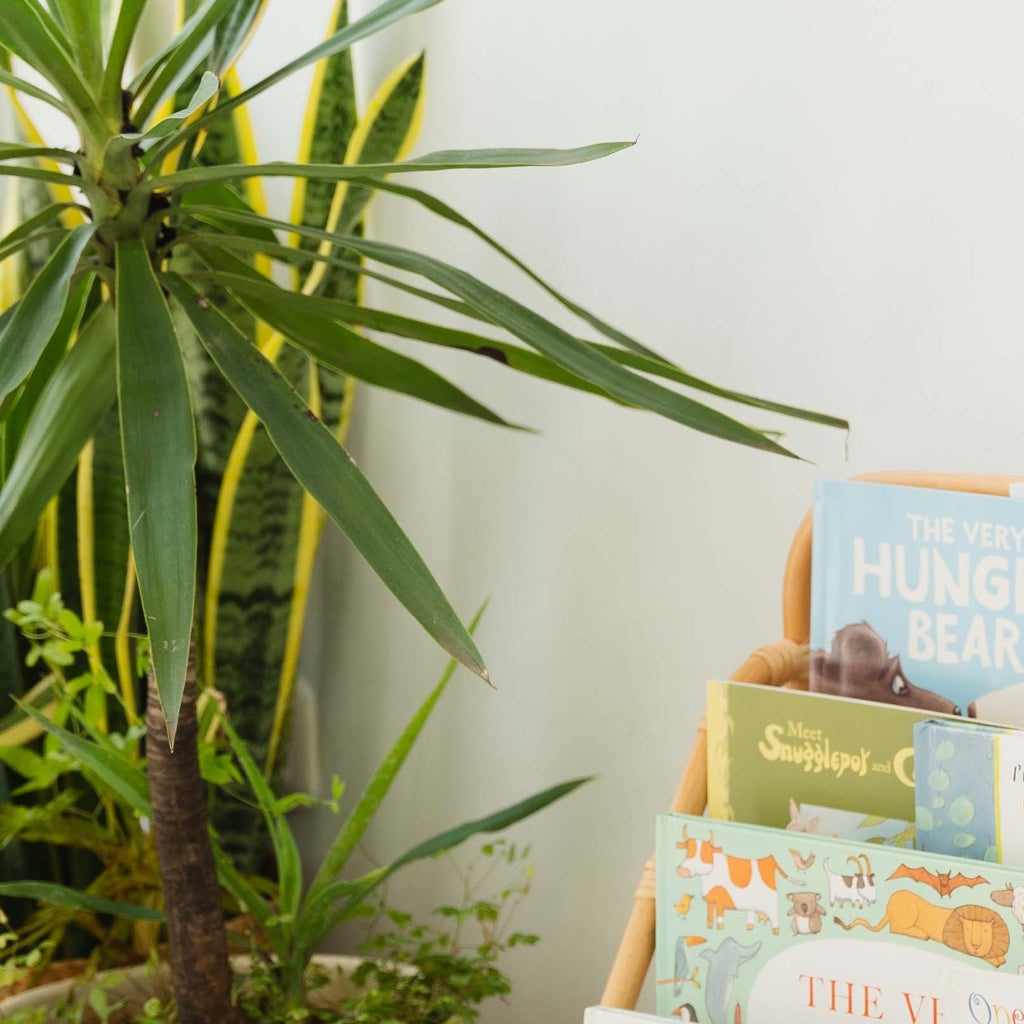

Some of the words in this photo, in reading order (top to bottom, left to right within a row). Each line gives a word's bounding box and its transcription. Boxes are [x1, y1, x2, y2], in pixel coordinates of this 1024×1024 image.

[907, 512, 955, 544] THE
[908, 609, 1024, 674] BEAR
[787, 720, 822, 741] Meet
[872, 761, 891, 774] and
[799, 974, 884, 1020] THE
